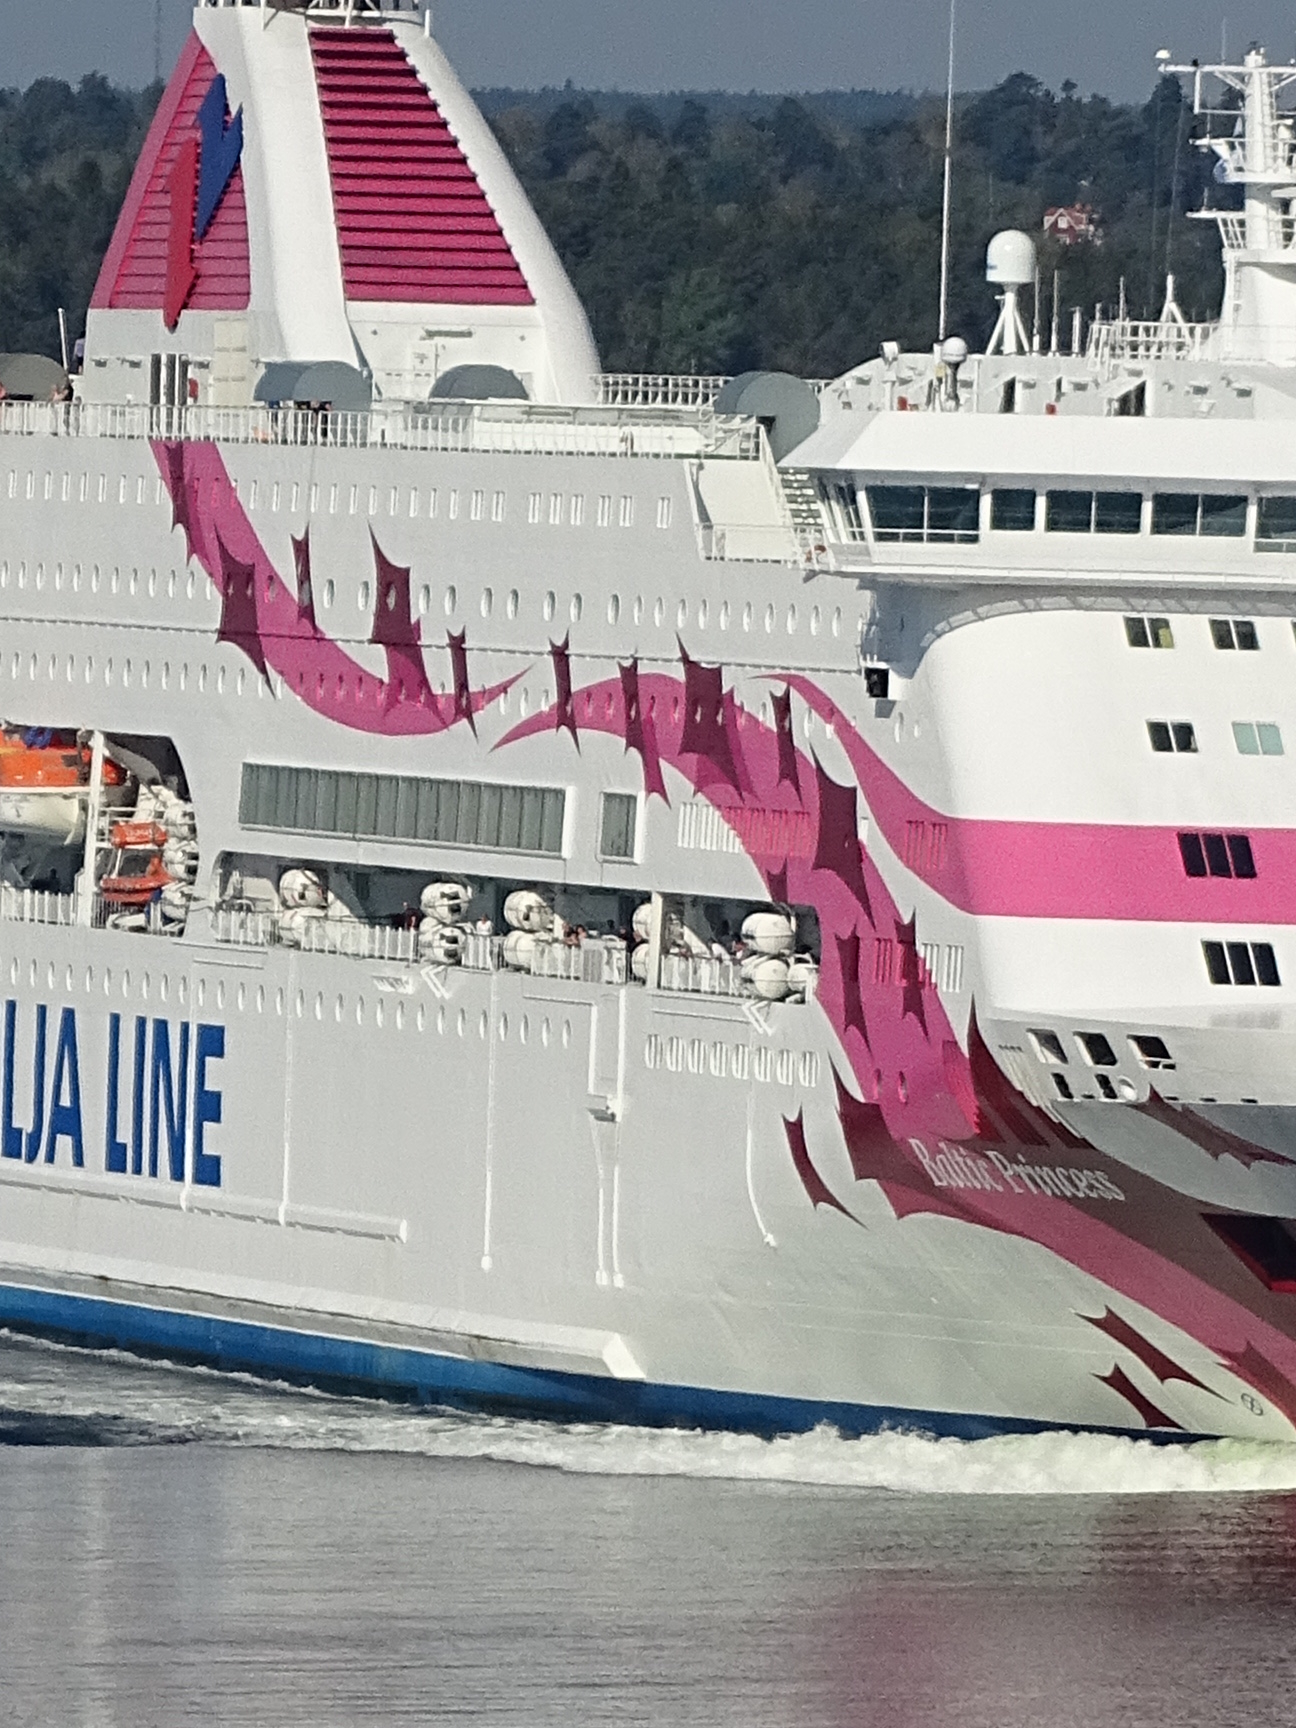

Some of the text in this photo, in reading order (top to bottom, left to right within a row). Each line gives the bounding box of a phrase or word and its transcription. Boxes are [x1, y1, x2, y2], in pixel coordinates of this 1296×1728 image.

[104, 1012, 225, 1187] LINE
[908, 1138, 1125, 1201] Baltic Princess
